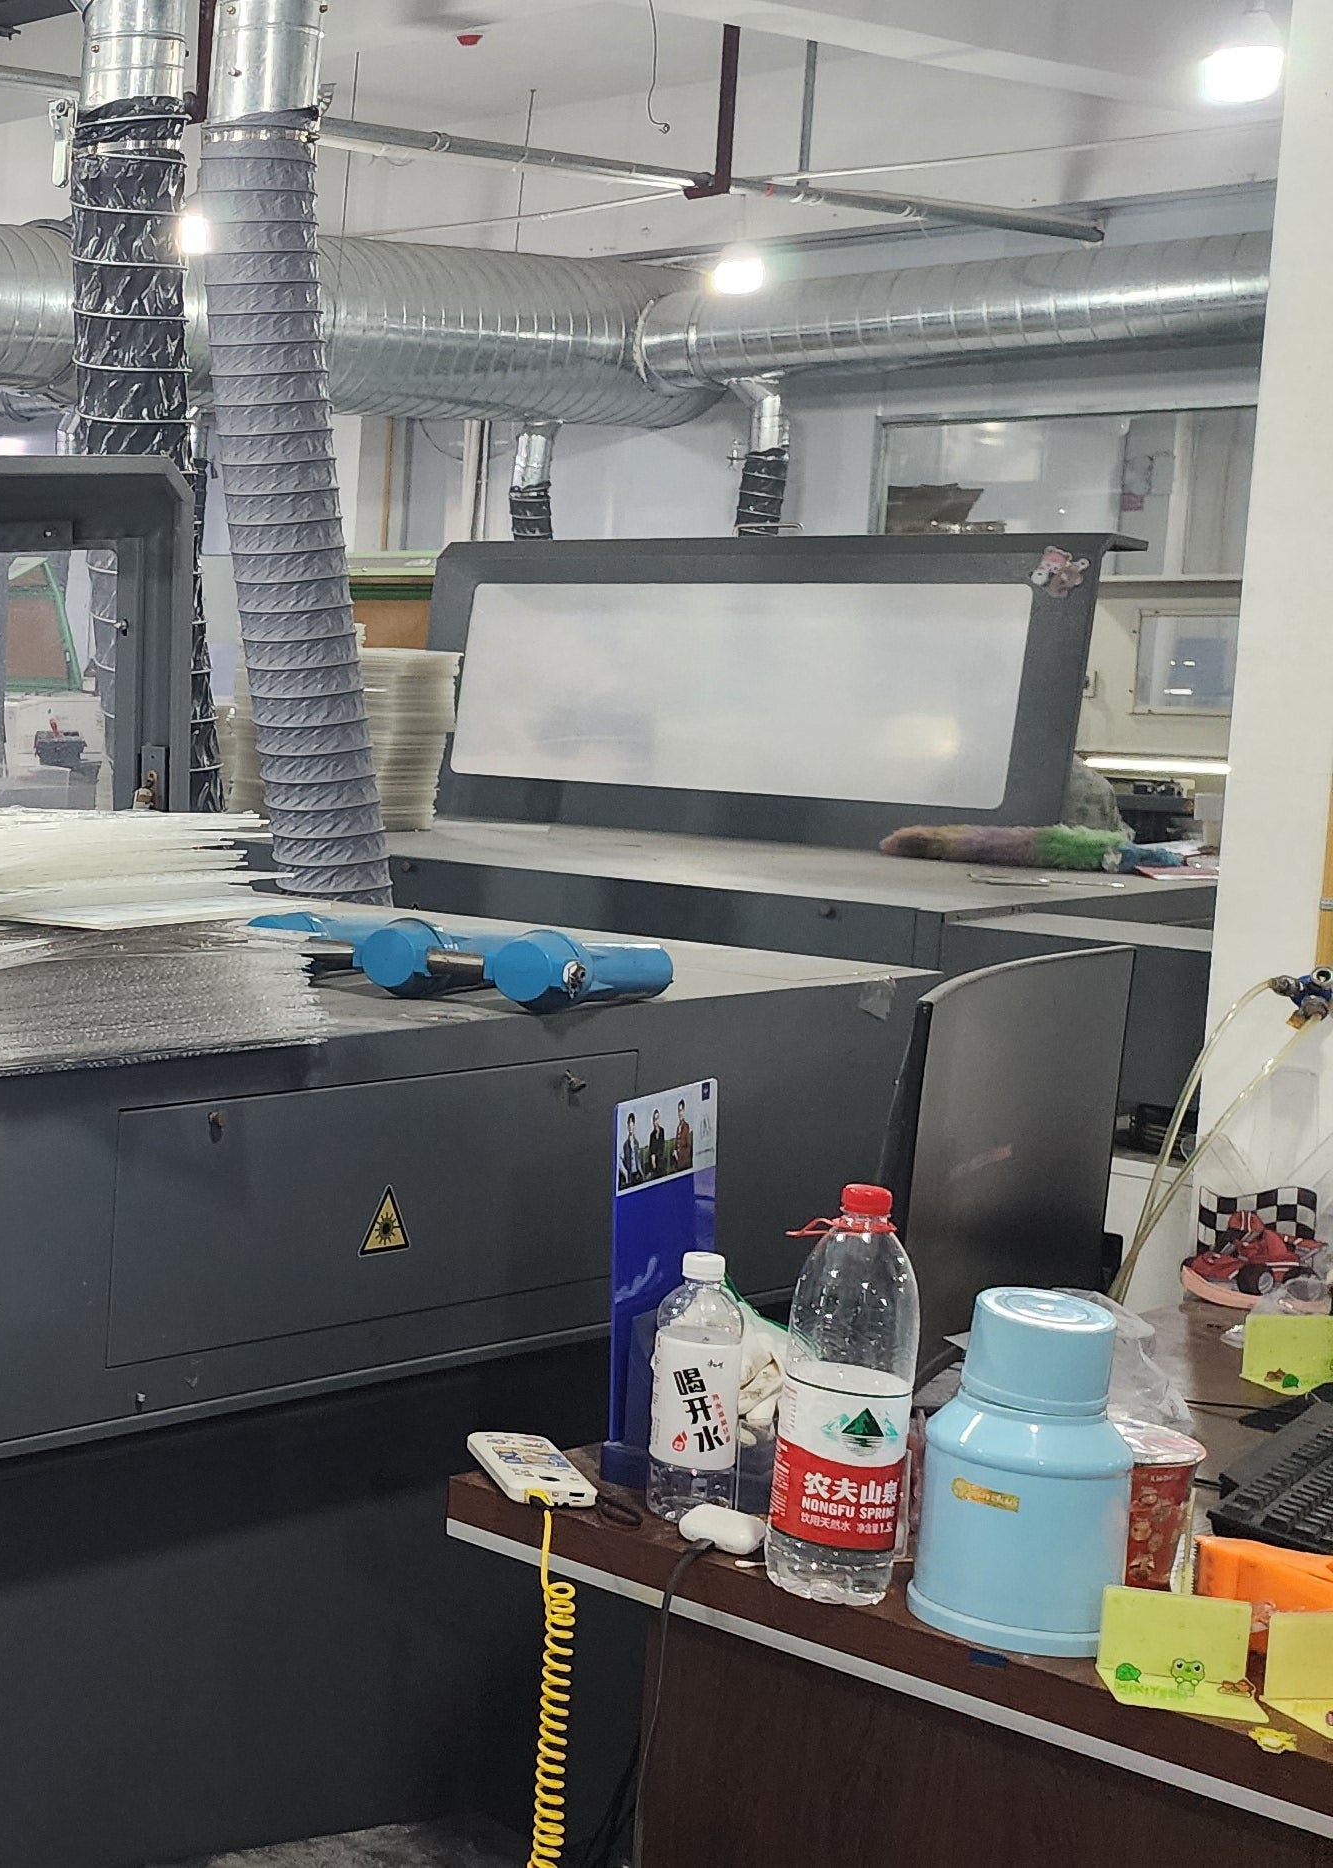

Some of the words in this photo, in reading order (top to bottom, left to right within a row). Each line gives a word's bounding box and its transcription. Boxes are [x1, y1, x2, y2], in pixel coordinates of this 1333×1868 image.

[673, 1367, 724, 1453] 喝开水
[803, 1471, 899, 1505] 农夫山泉
[801, 1495, 856, 1518] NONGFU
